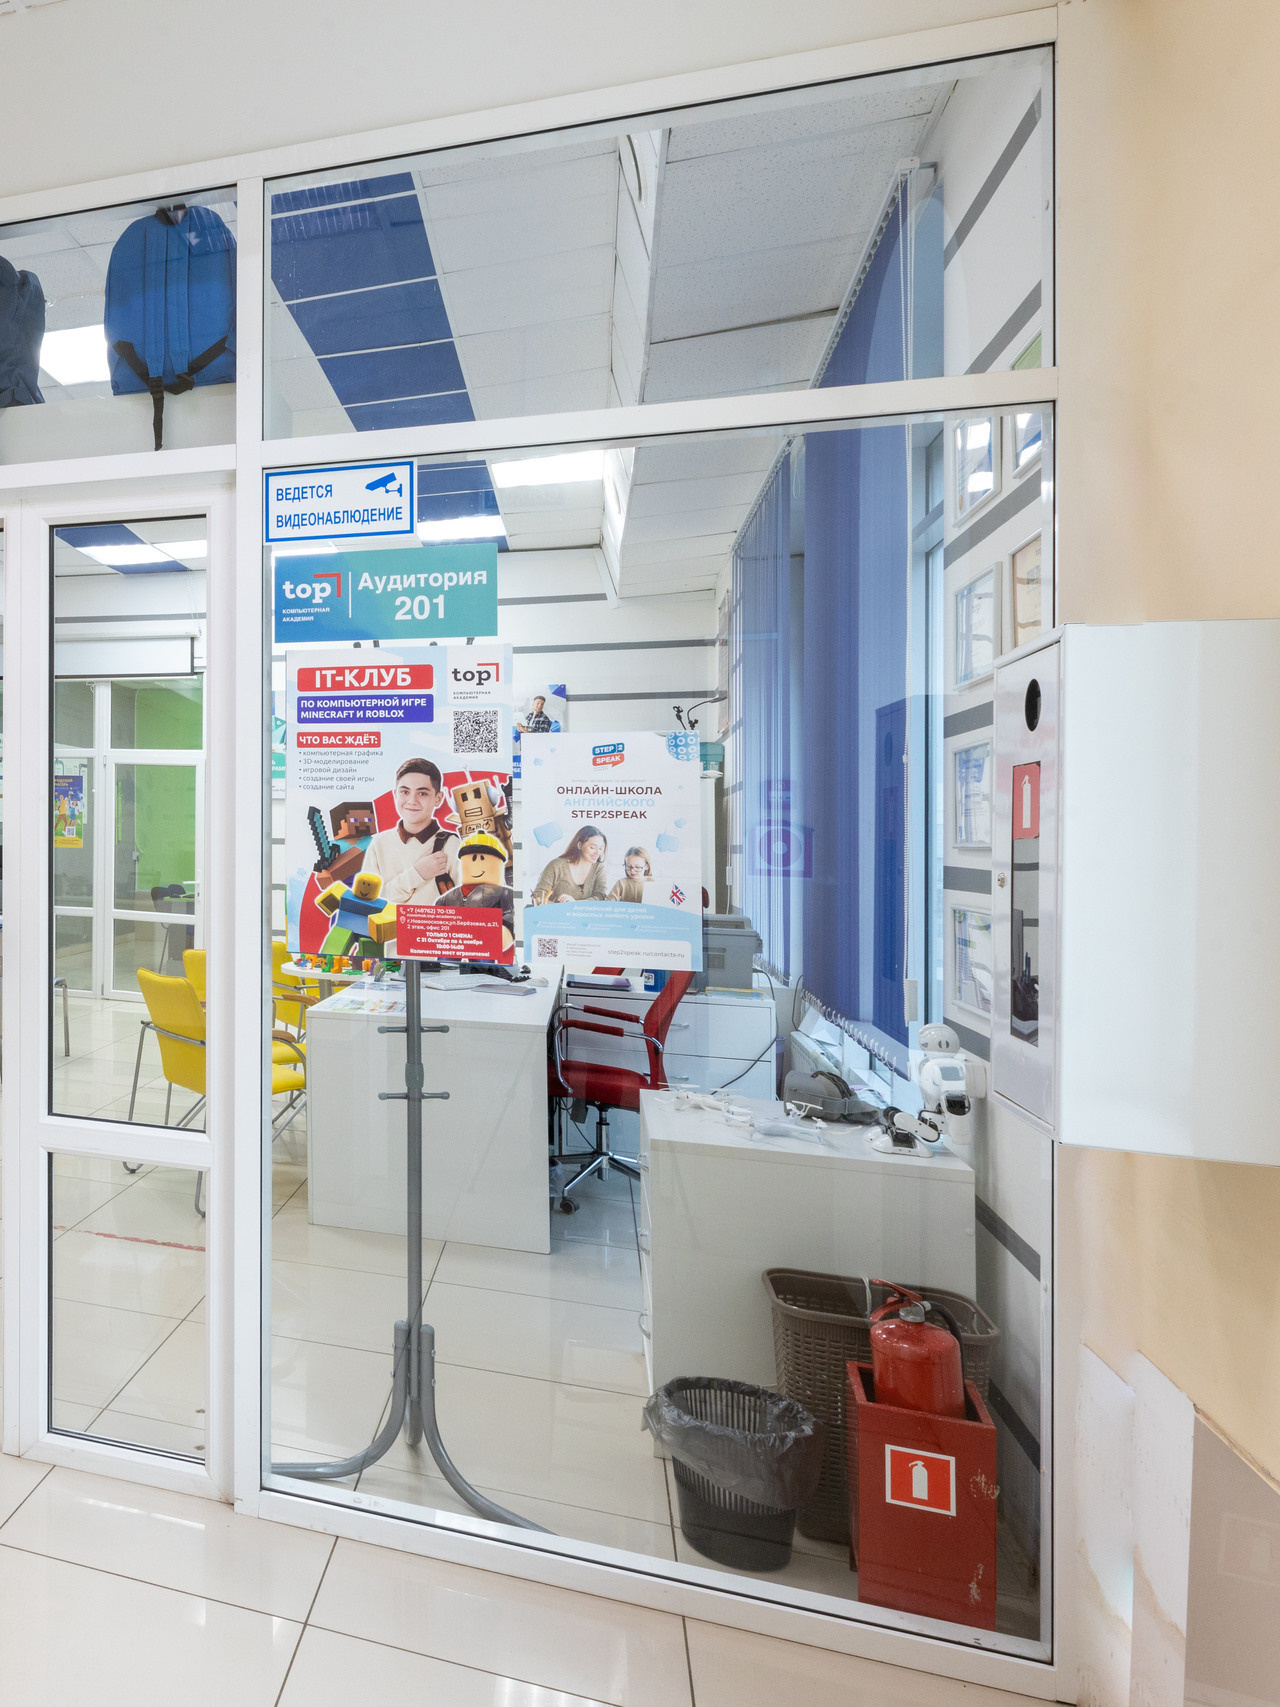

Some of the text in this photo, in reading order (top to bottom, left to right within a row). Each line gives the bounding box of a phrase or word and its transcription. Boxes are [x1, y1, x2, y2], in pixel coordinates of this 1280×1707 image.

[276, 484, 333, 503] ВЕДЕТСЯ
[276, 506, 403, 530] ВИДЕОНАБЛЮДЕНИЕ
[357, 570, 487, 595] Аудитория
[282, 580, 332, 604] top
[394, 594, 445, 621] 201
[282, 615, 314, 623] АКАДЕМИЯ
[314, 668, 412, 688] IT-КЛУБ
[452, 667, 492, 686] top
[301, 697, 427, 708] ПО КОМПЬЮТЕРНОЙ ИГРЕ
[301, 709, 405, 719] MINECRAFT И ROBLOX
[300, 734, 378, 746] ЧТО ВАС ЖДЁТ:
[594, 745, 614, 754] STEP
[596, 755, 621, 764] SPEAK
[557, 784, 663, 795] ОНЛАЙН-ШКОЛА
[564, 796, 655, 807] АНГЛИЙСКОГО
[571, 810, 647, 819] STEP2SPEAK
